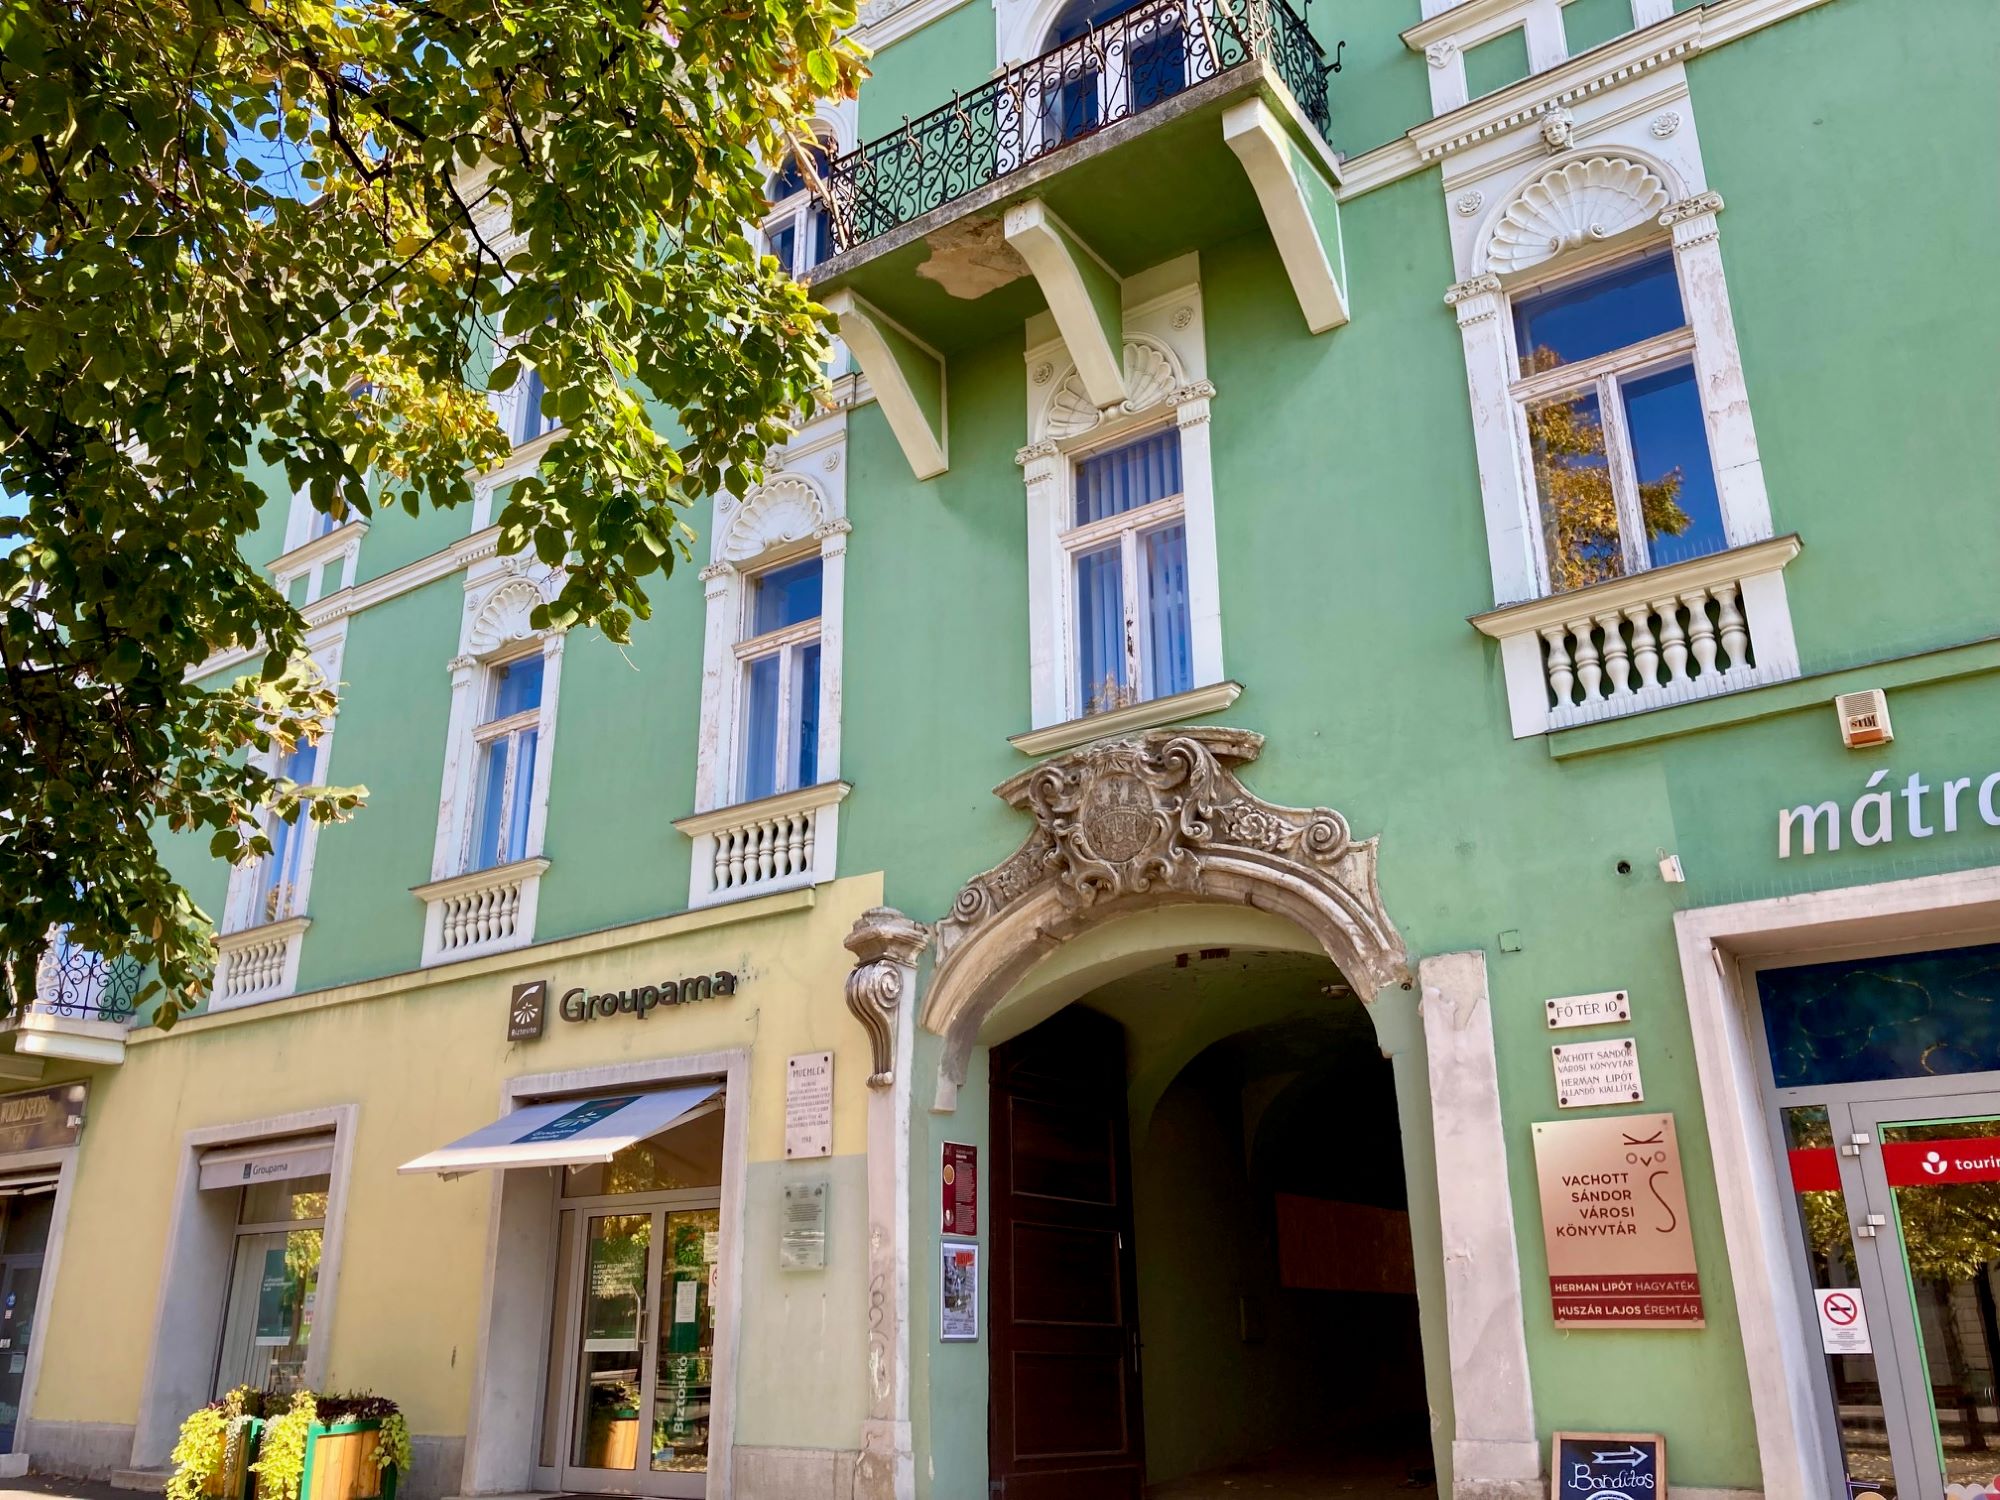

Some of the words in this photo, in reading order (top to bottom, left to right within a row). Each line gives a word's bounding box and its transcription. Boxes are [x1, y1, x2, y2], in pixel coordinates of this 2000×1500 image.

[559, 971, 738, 1023] Groupama
[1576, 1001, 1600, 1016] TÉR
[1557, 1052, 1594, 1064] VACHOTT
[1561, 1076, 1600, 1087] HERMAN
[1605, 1070, 1632, 1083] LIPÓT
[253, 1163, 288, 1176] Groupama
[1562, 1173, 1629, 1187] VACHOTT
[1571, 1189, 1632, 1203] SÁNDOR
[1579, 1206, 1635, 1219] VÁROSI
[1556, 1223, 1637, 1237] KÖNYVTÁR
[1555, 1283, 1599, 1292] HERMAN
[1602, 1280, 1633, 1291] LIPÓT
[1636, 1280, 1695, 1291] HAGYATÉK
[1558, 1304, 1602, 1315] HUSZÁR
[1605, 1305, 1641, 1315] LAJOS
[1644, 1303, 1698, 1315] ÉREMTÁR
[1568, 1461, 1654, 1491] Banditos
